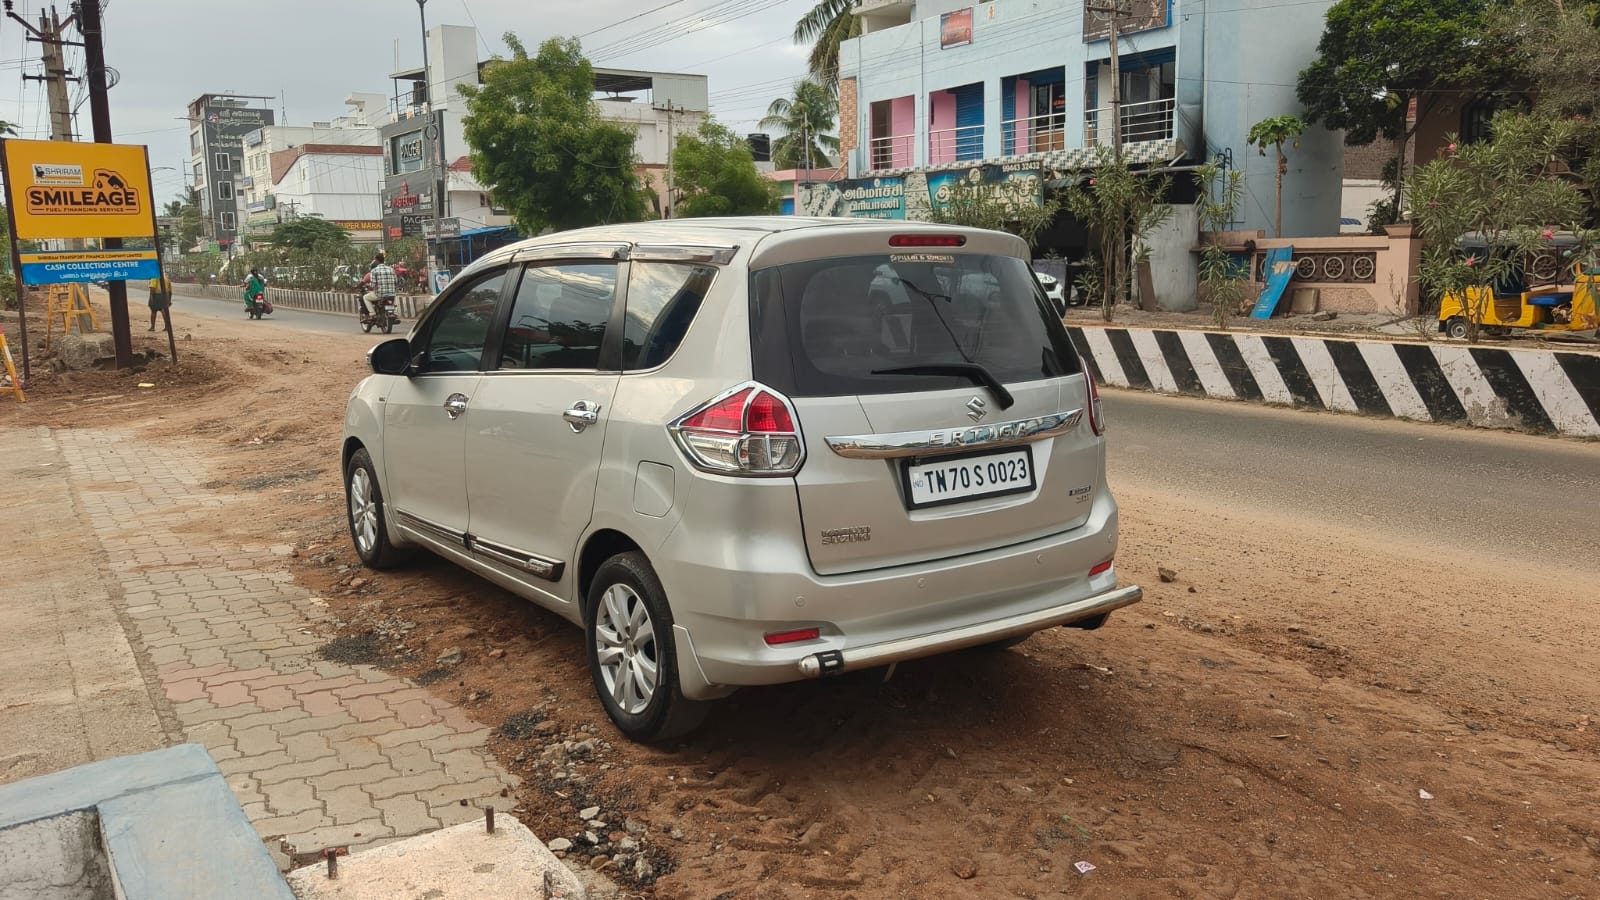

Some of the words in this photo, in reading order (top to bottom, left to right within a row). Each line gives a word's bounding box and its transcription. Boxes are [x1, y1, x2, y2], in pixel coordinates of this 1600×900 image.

[45, 167, 81, 175] SHRIRAM
[30, 190, 137, 206] SMILEAGE
[45, 263, 66, 271] CASH
[66, 262, 112, 270] COLLECTION
[928, 422, 1027, 446] ERTIGA
[973, 464, 985, 486] S
[987, 458, 1028, 484] 0023
